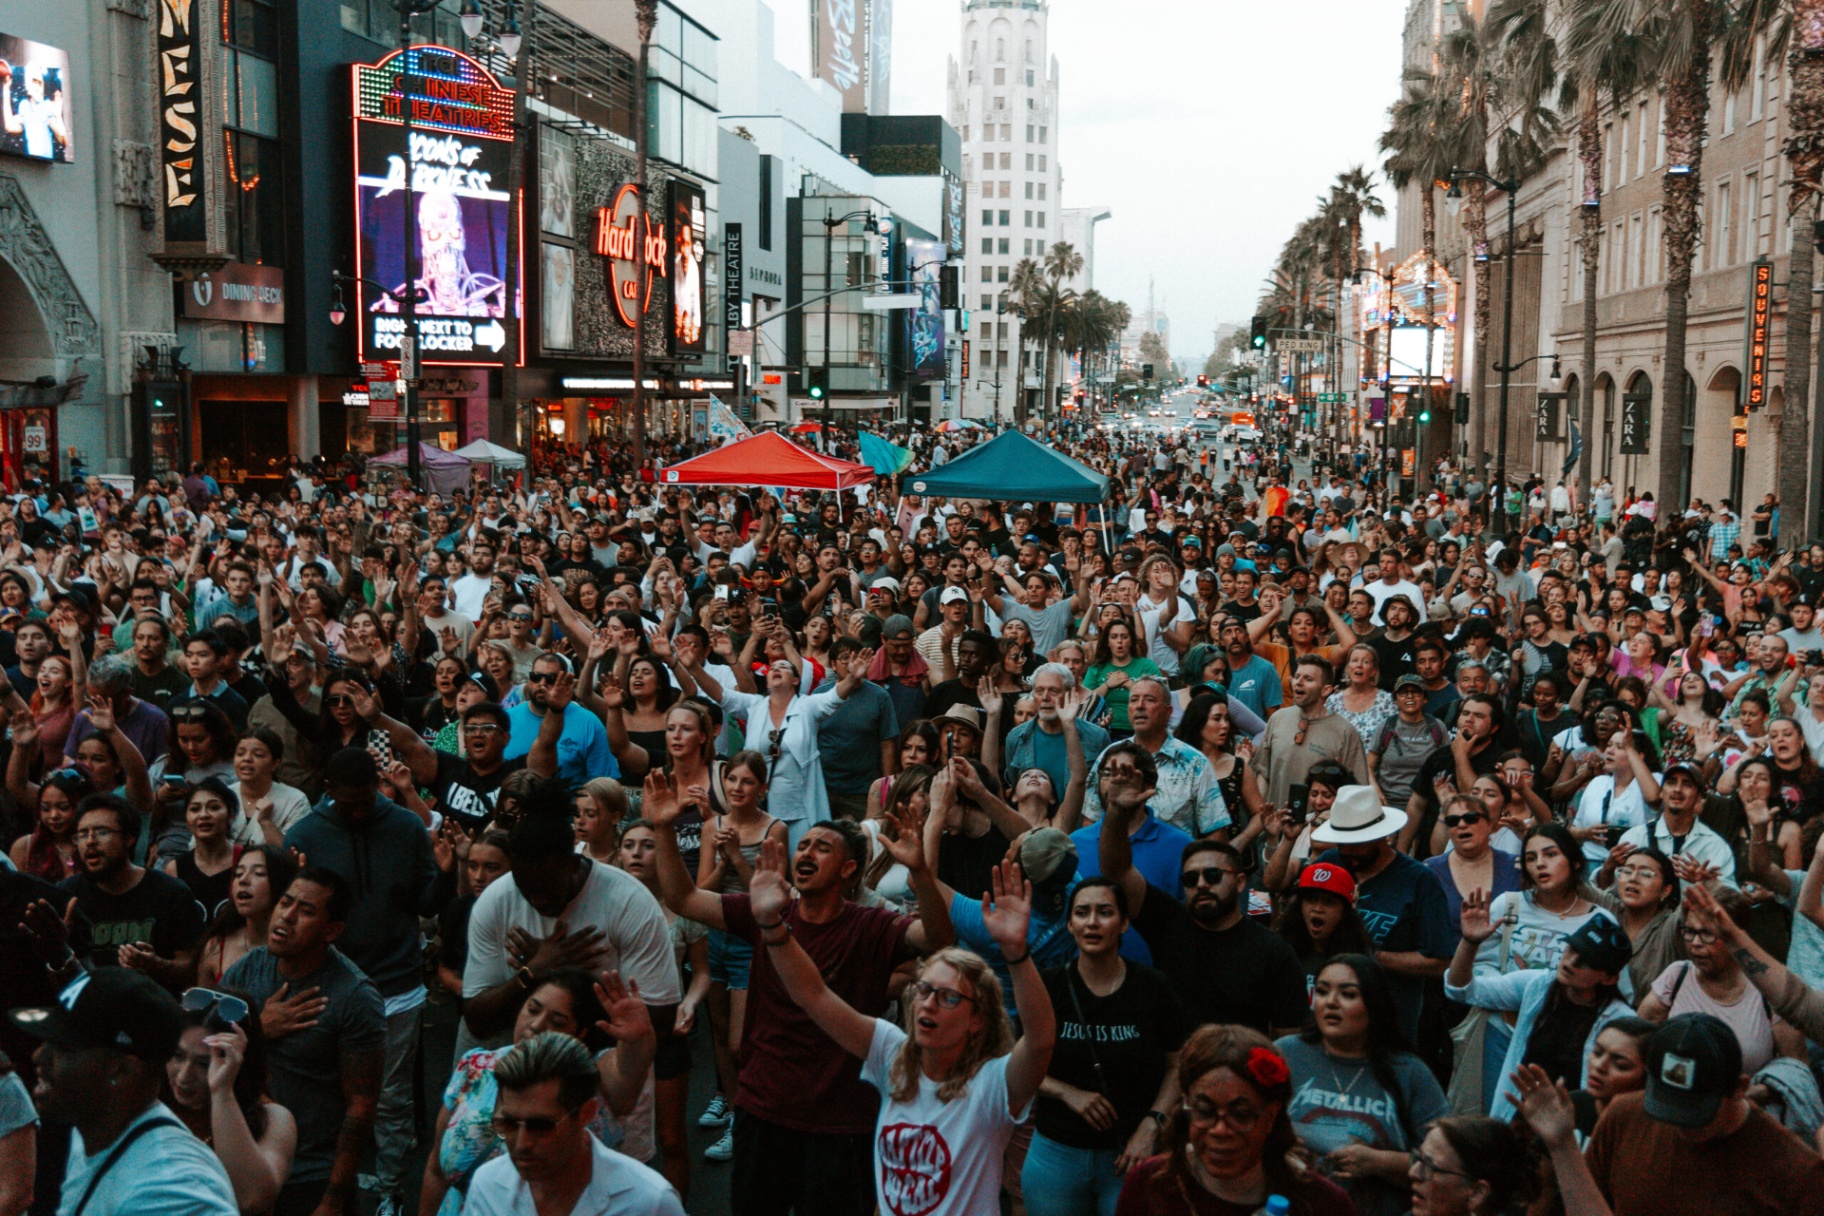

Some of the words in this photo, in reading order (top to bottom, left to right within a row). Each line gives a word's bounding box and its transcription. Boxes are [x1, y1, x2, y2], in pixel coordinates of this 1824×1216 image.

[409, 132, 461, 165] ICONS
[460, 145, 484, 167] OF
[375, 154, 493, 199] DRKNESS
[598, 205, 636, 261] Hard
[644, 211, 668, 278] ock
[728, 232, 741, 296] THEATRE
[749, 266, 783, 286] SEPHORA
[221, 282, 257, 302] DINING
[258, 286, 283, 305] DECK
[374, 316, 419, 335] RIGH
[419, 319, 452, 336] NEXT
[453, 320, 473, 336] TO
[1750, 265, 1770, 404] SOUVENIRS
[374, 333, 403, 350] FOO
[418, 335, 474, 352] LOCKER
[961, 341, 969, 363] Locker
[1279, 340, 1297, 350] PED
[1299, 340, 1319, 350] XING
[962, 363, 970, 379] Foot
[1537, 398, 1549, 436] ZARA
[1621, 401, 1635, 447] ZARA
[1510, 924, 1569, 950] STA
[1509, 940, 1566, 969] WAR
[1060, 1021, 1093, 1040] JESUS
[1096, 1025, 1108, 1042] IS
[1110, 1025, 1141, 1042] KING
